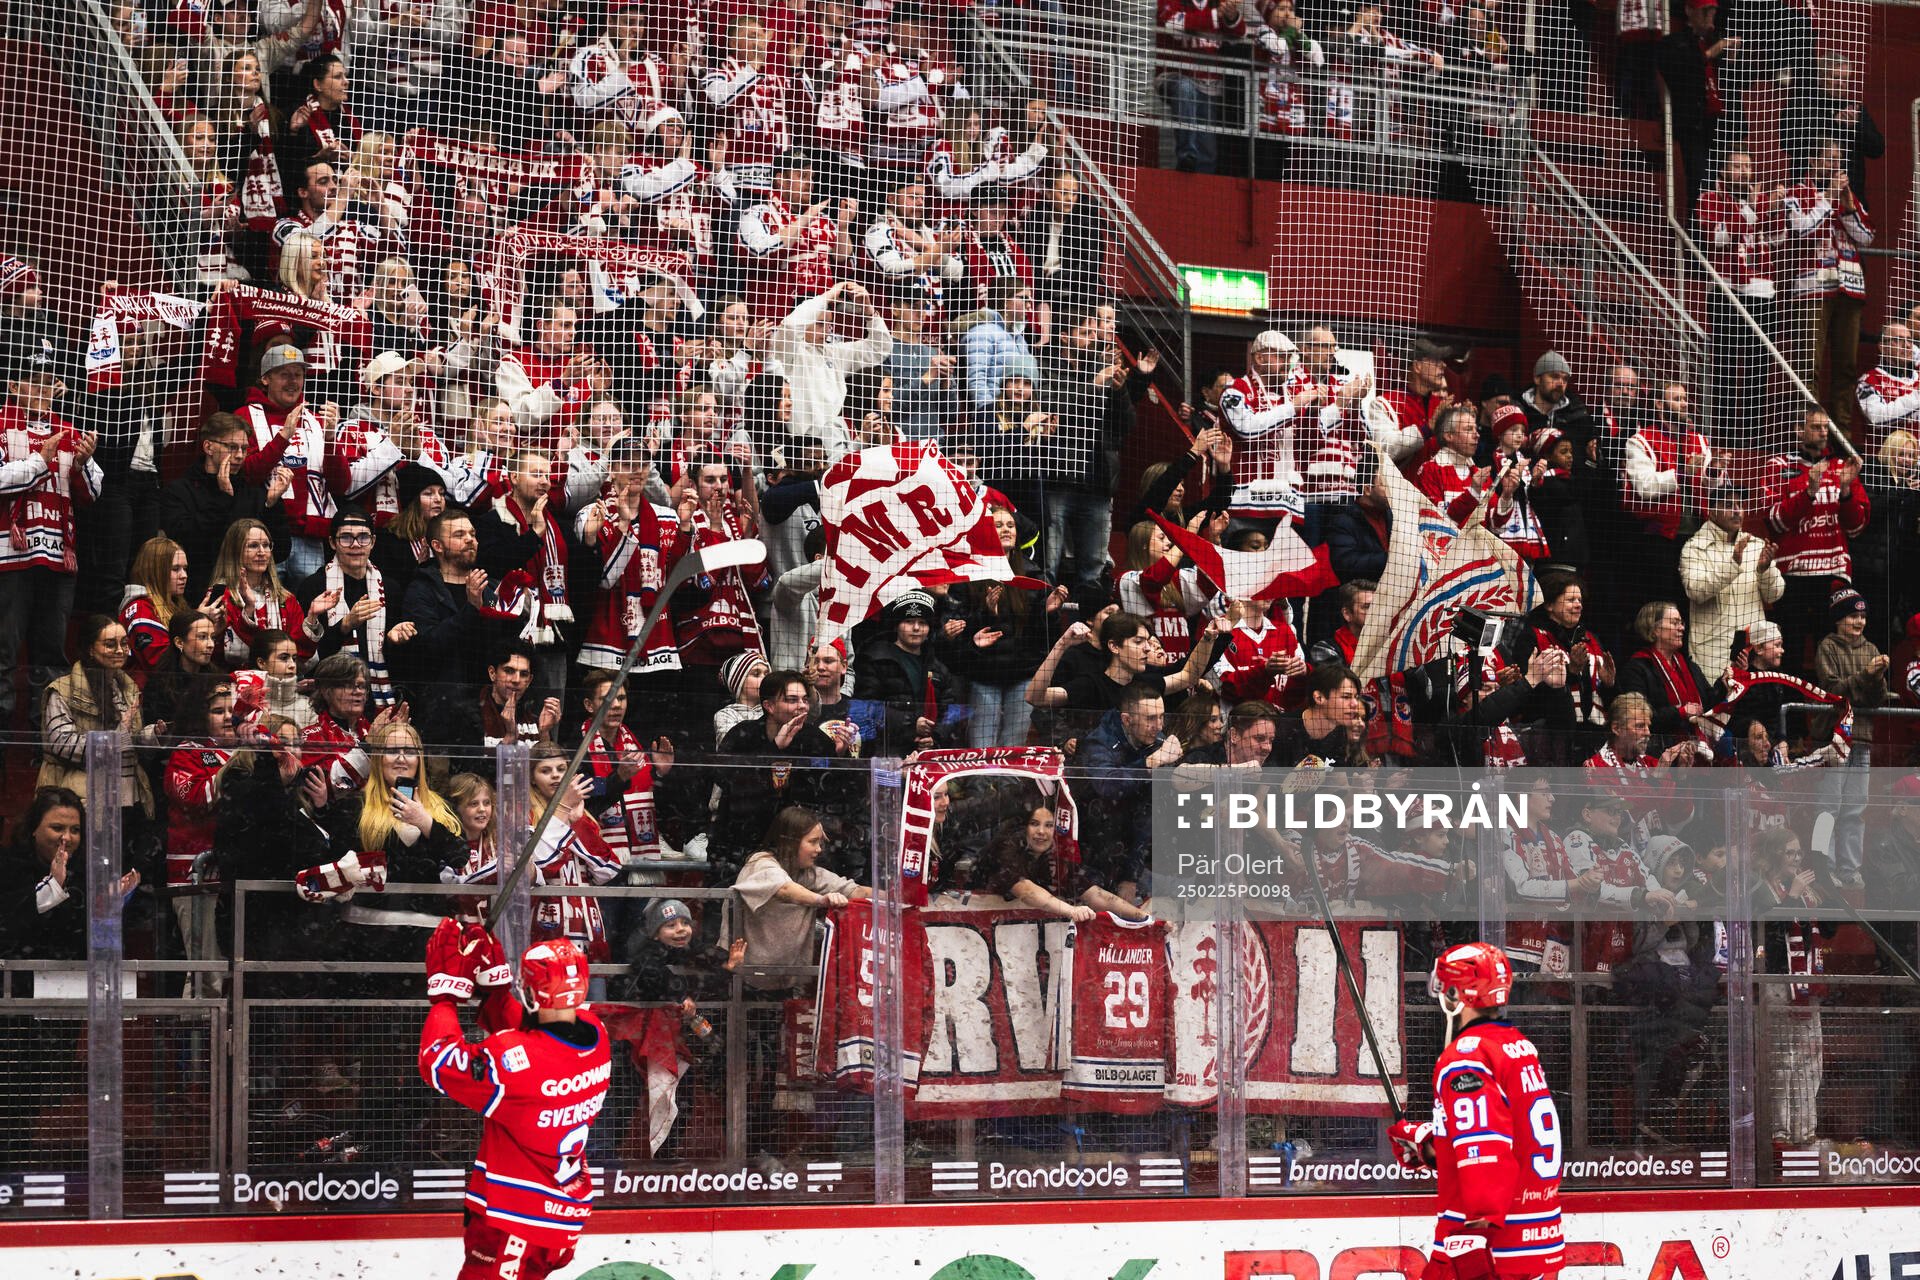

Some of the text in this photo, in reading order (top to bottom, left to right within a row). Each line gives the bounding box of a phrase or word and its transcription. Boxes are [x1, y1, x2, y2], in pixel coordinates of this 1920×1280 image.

[1098, 942, 1154, 965] HÅLLANDER
[1103, 971, 1150, 1029] 29
[1095, 1068, 1158, 1082] BILBOLAGET
[1453, 1095, 1488, 1131] 91
[990, 1160, 1129, 1189] Brandcode
[1562, 1154, 1694, 1178] randcode.se
[233, 1171, 400, 1203] Brandcode
[613, 1167, 799, 1194] brandcode.se
